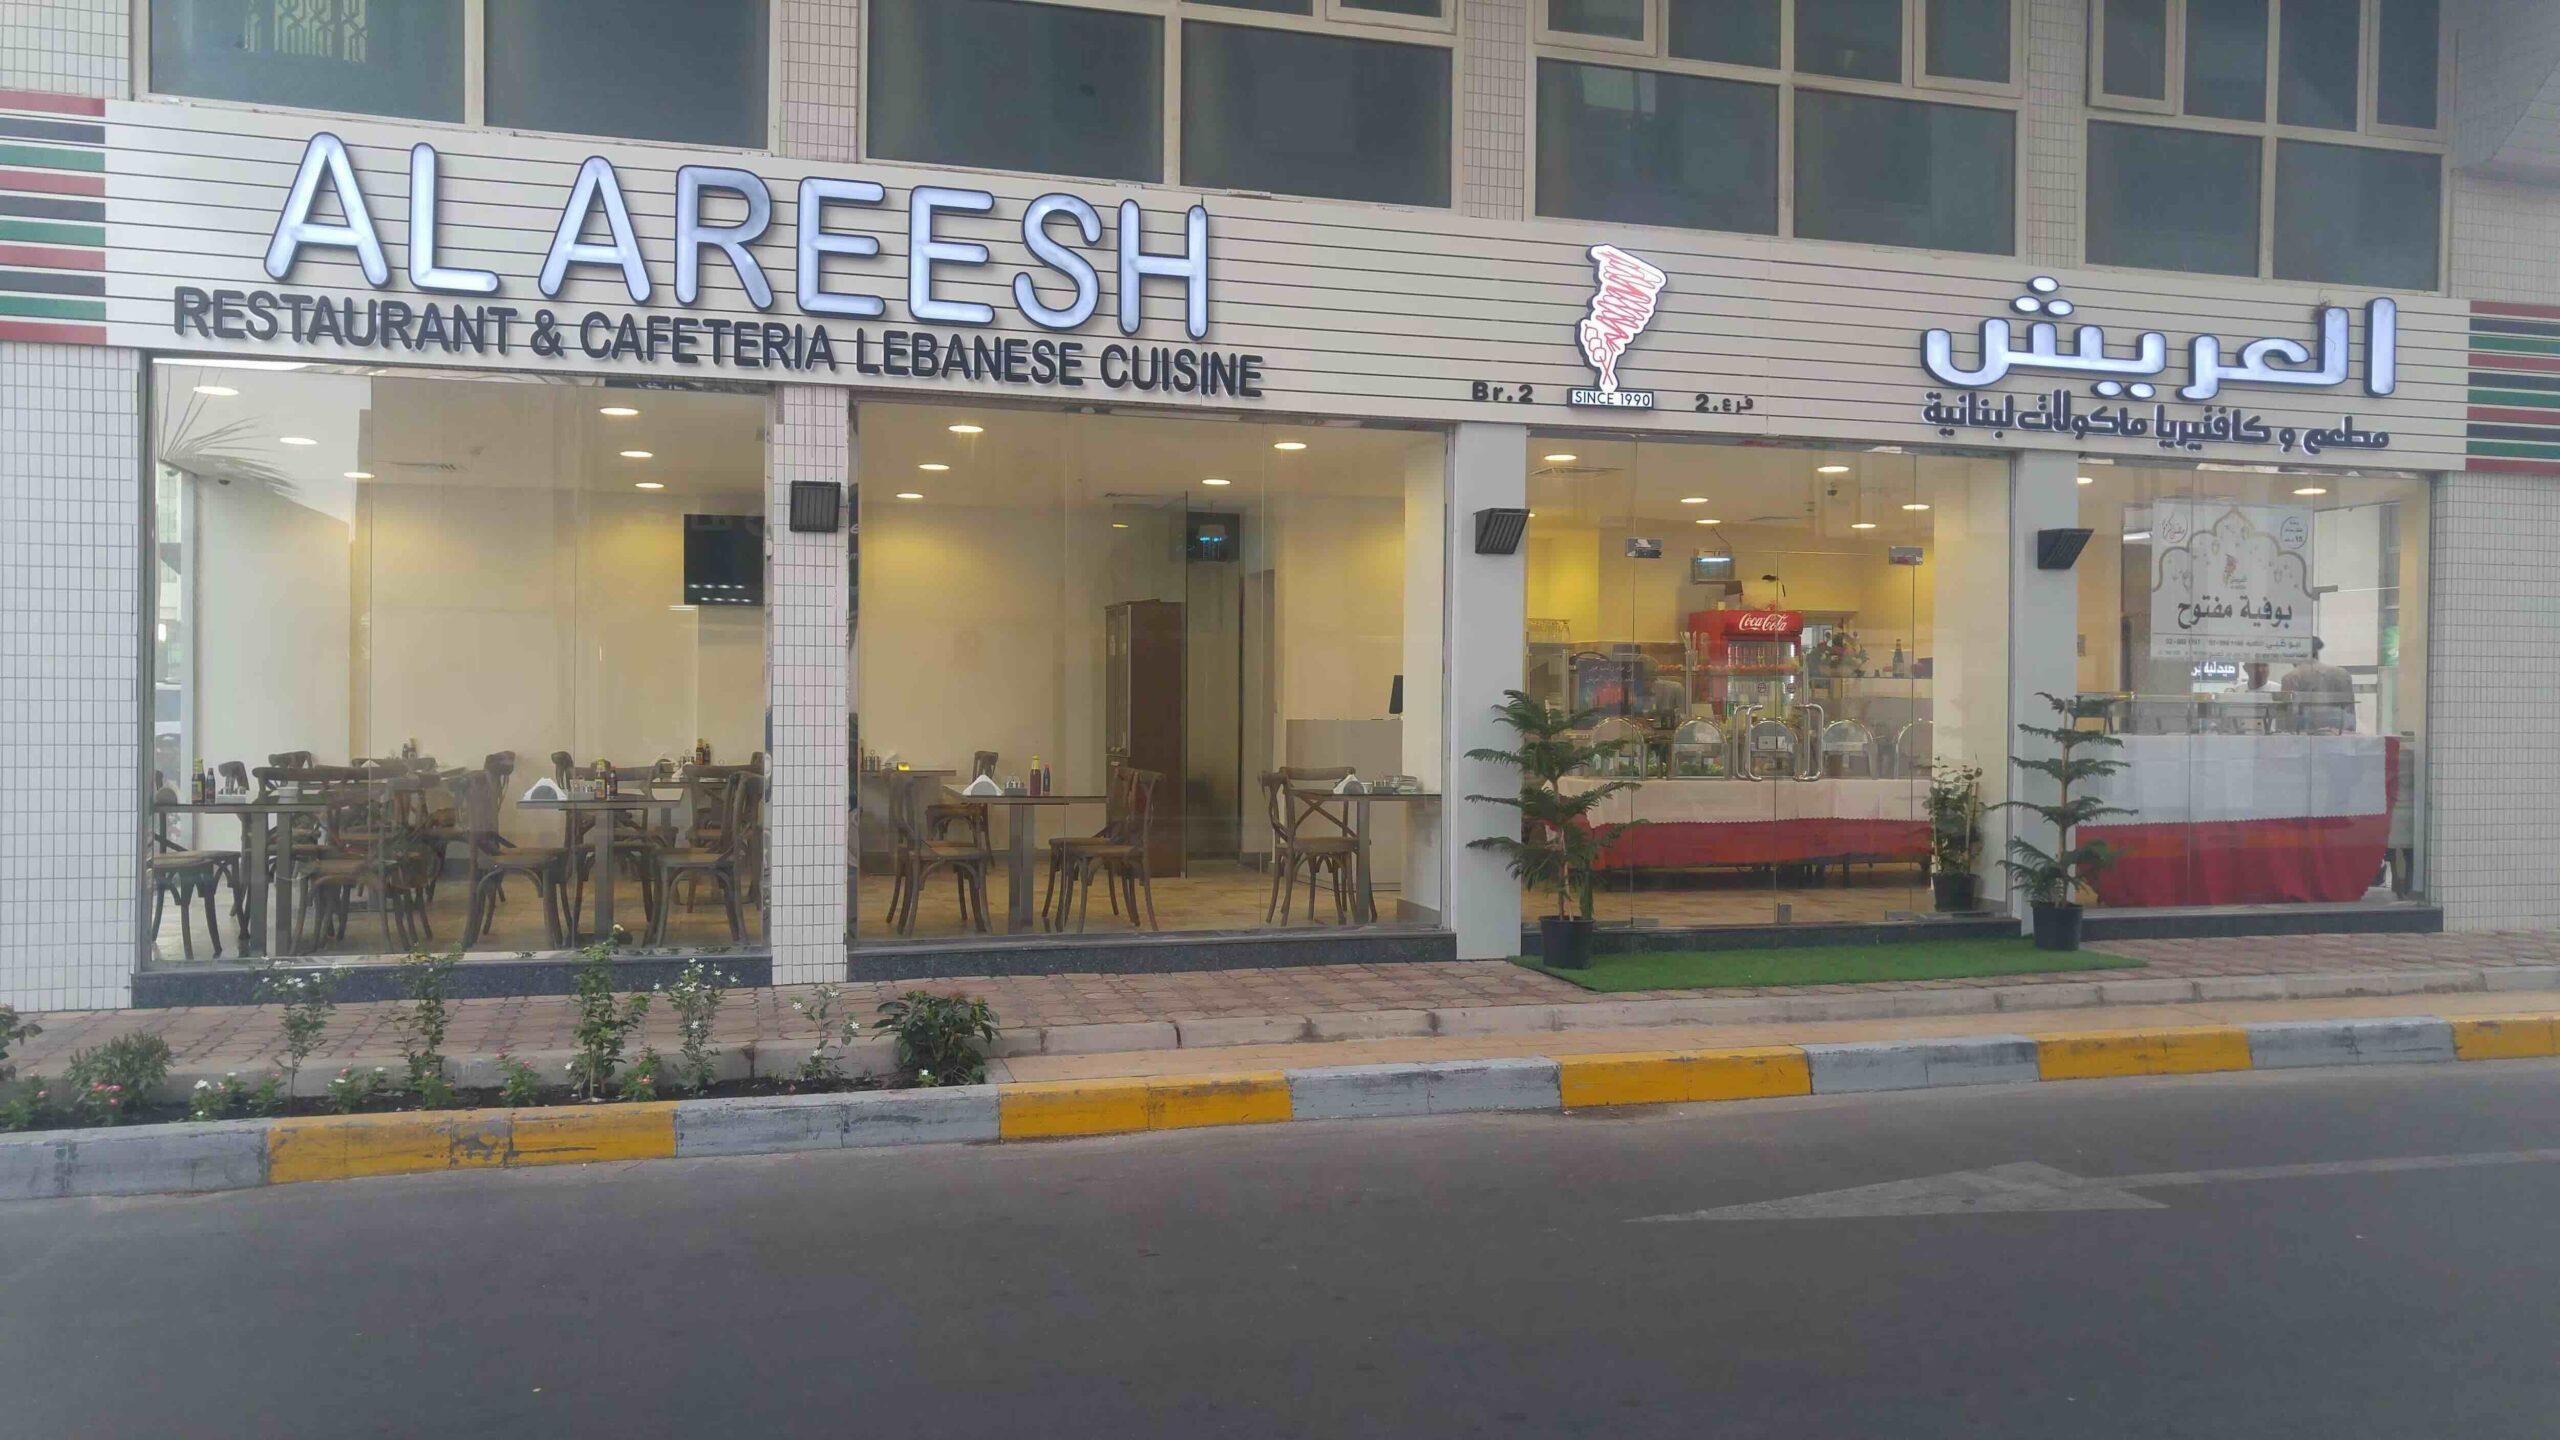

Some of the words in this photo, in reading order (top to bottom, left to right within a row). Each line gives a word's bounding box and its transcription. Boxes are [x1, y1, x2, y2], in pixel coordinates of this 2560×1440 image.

[263, 131, 501, 296] AL
[538, 156, 1210, 341] AREESH
[174, 286, 517, 356] RESTAURANT
[530, 309, 564, 357] &
[580, 312, 836, 372] CAFETERIA
[856, 328, 1084, 387] LEBANESE
[1101, 344, 1264, 398] CUISINE
[1920, 276, 2397, 401] العريش
[1575, 391, 1614, 405] SINCE
[1620, 393, 1650, 406] 1990
[1922, 391, 2014, 439] لبنانية
[2155, 404, 2272, 451] كافتيريا
[2279, 427, 2296, 453] و
[2303, 416, 2390, 455] مطعم
[2178, 595, 2232, 629] مفتوح
